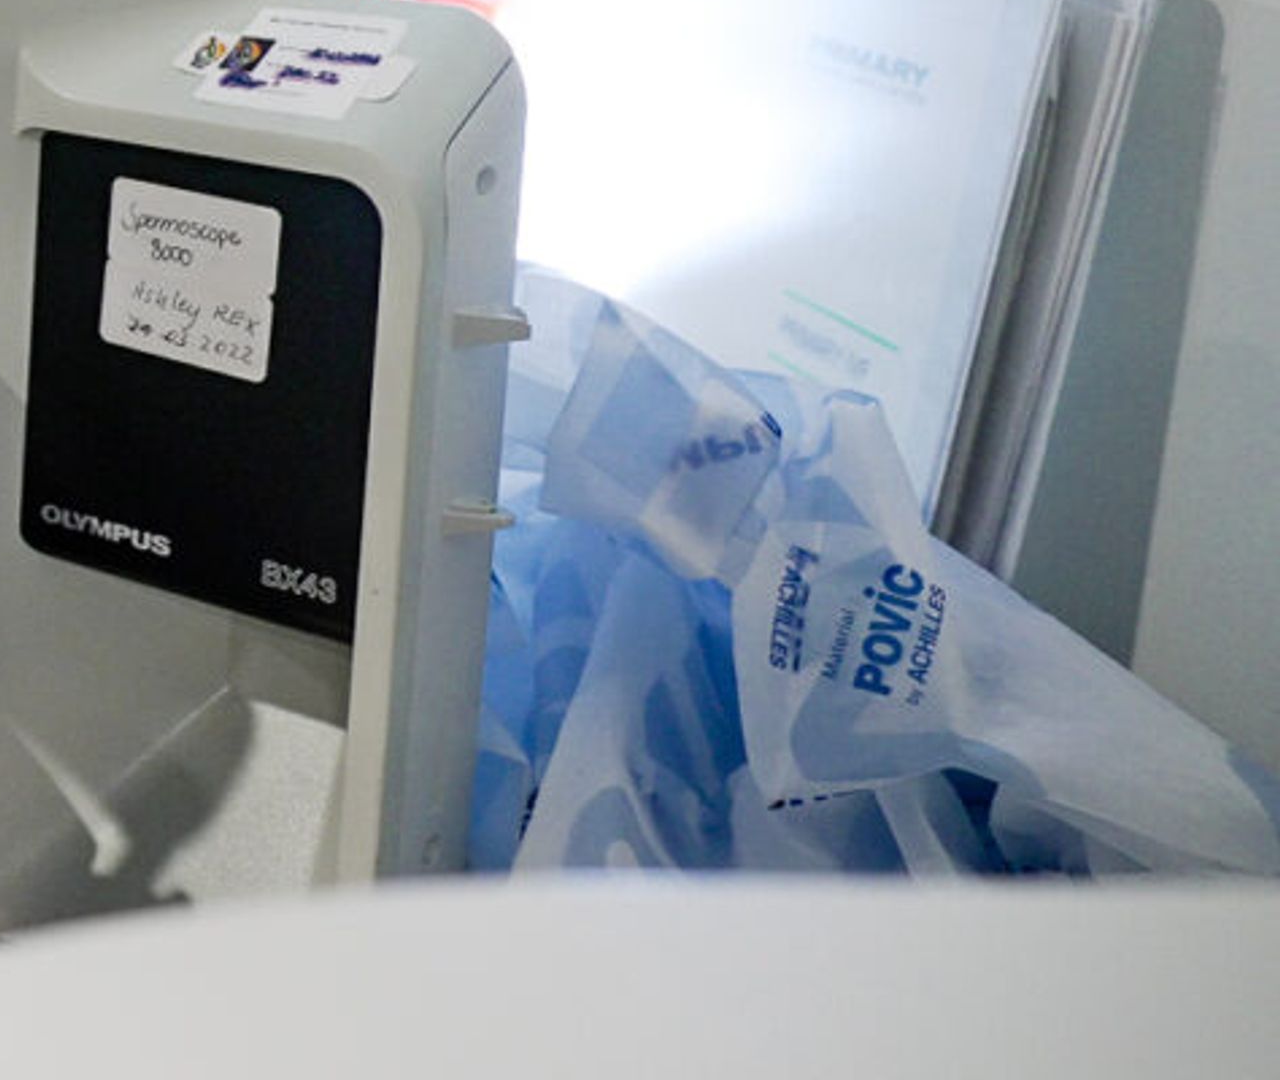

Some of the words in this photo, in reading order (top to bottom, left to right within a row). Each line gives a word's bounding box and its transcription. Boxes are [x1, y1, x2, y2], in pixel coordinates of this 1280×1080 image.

[121, 201, 242, 250] Spermoscope
[150, 237, 193, 266] 8000
[40, 503, 172, 558] OLYMPUS
[259, 558, 338, 605] BX43
[820, 607, 855, 680] Material
[907, 583, 947, 684] ACHILLES
